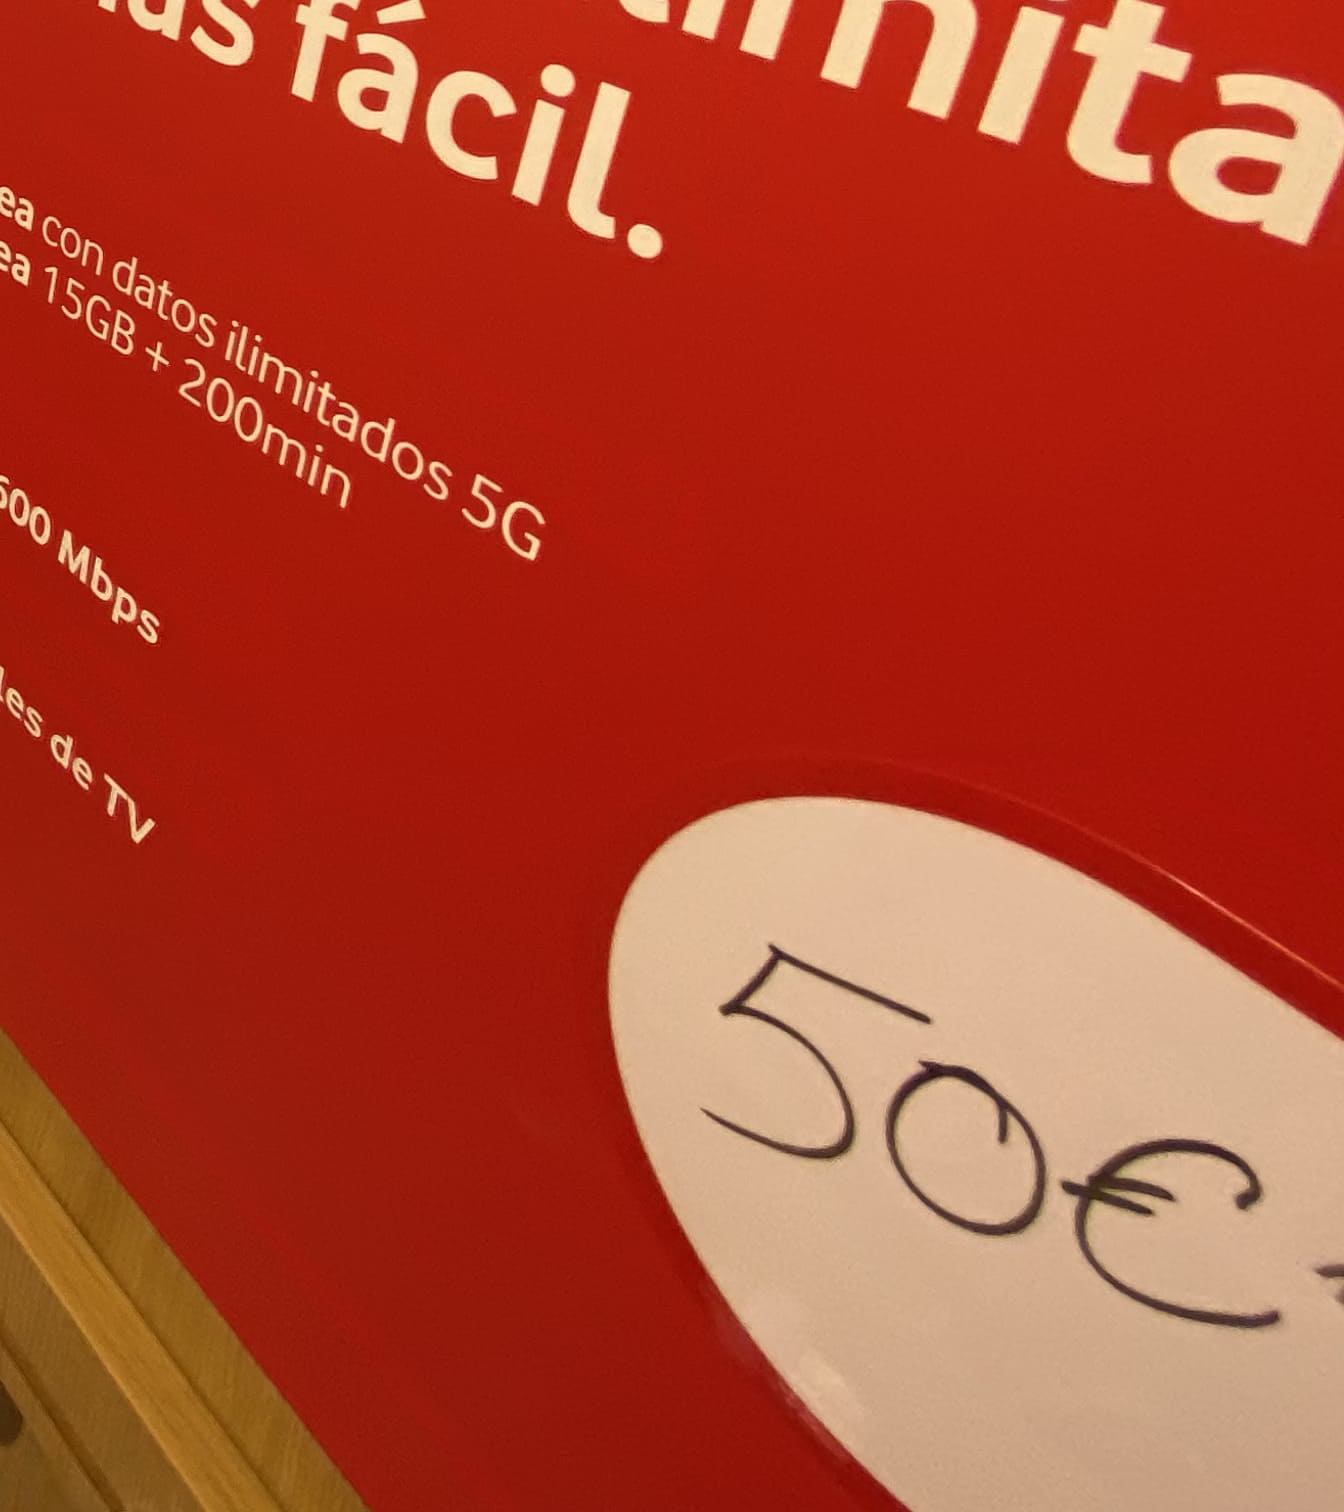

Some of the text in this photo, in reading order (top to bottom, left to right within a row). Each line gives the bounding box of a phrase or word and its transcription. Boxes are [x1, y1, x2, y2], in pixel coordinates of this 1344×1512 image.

[42, 215, 104, 276] con
[112, 256, 218, 348] datos
[224, 320, 453, 501] ilimitados
[461, 473, 545, 561] 5G
[44, 266, 136, 355] 15GB
[178, 358, 351, 509] 200min
[57, 529, 160, 644] Mbps
[50, 734, 93, 791] de
[700, 943, 1283, 1329] 50€
